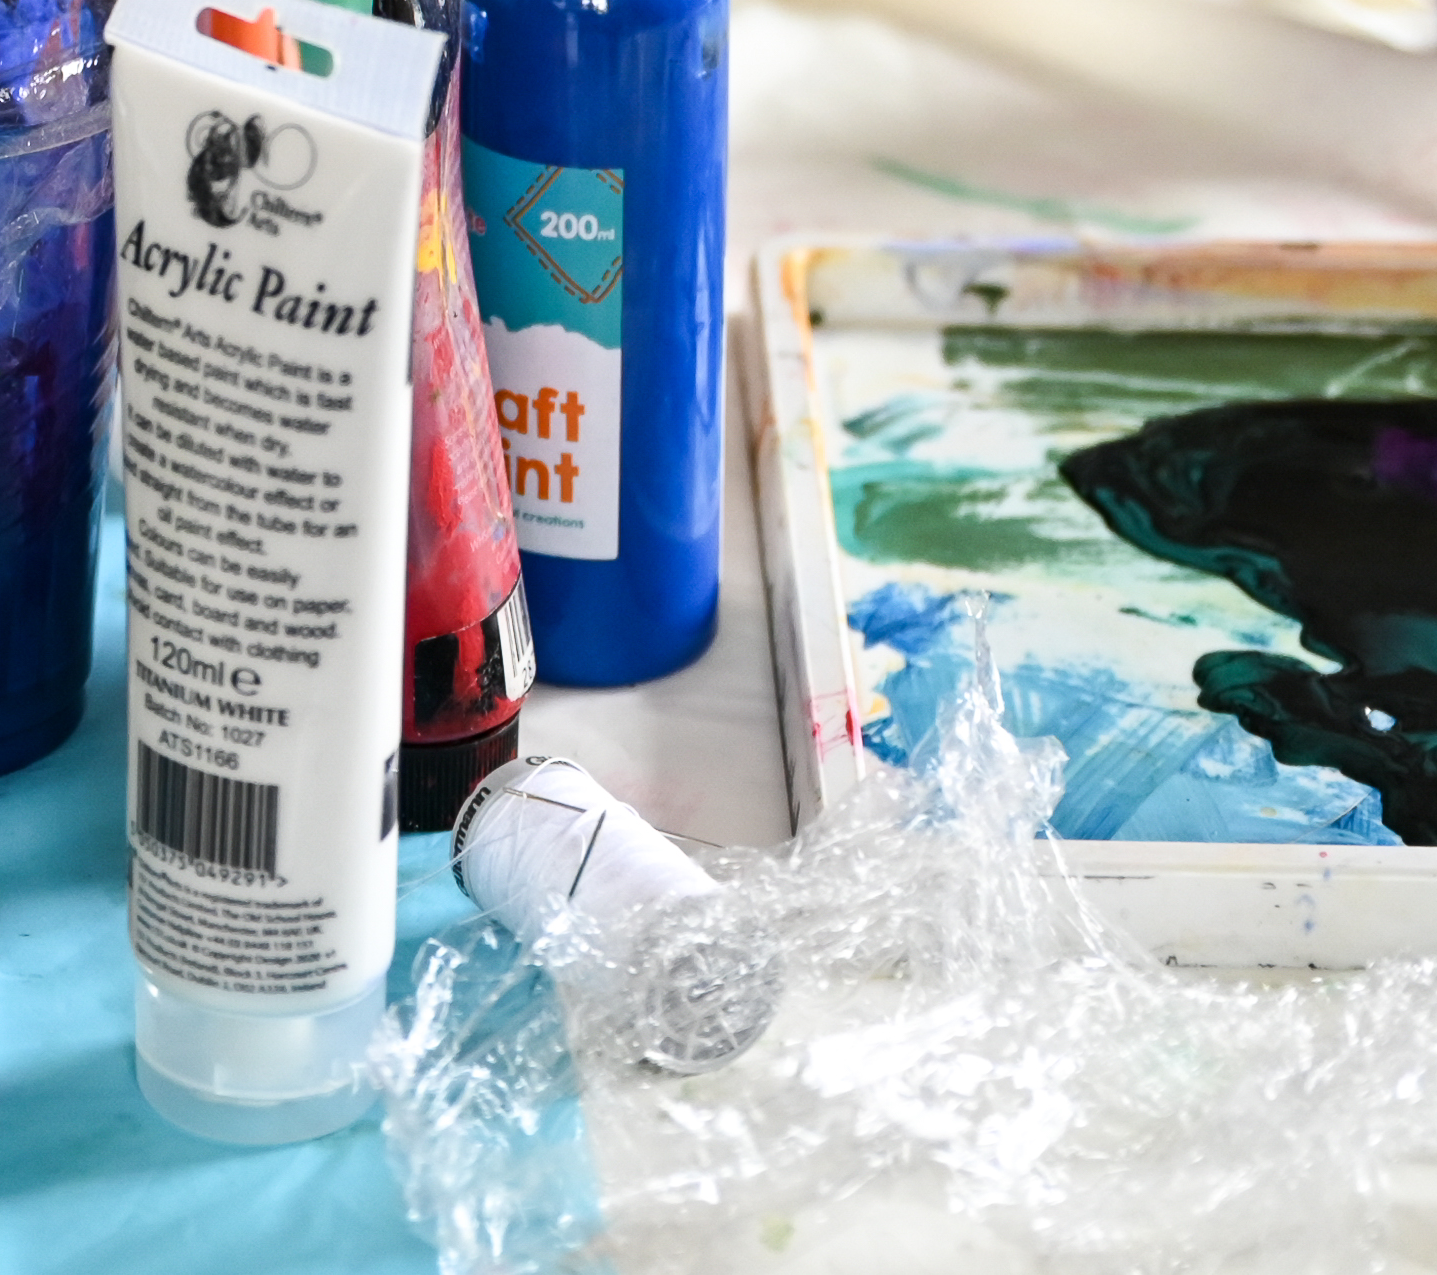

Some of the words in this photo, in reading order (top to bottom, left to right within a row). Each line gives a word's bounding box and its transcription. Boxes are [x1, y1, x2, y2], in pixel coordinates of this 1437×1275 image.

[120, 218, 244, 302] Acrylic
[250, 264, 380, 337] Paint
[494, 386, 586, 443] aft
[521, 511, 586, 530] creations
[150, 634, 226, 688] 120ml
[217, 698, 292, 728] WHITE
